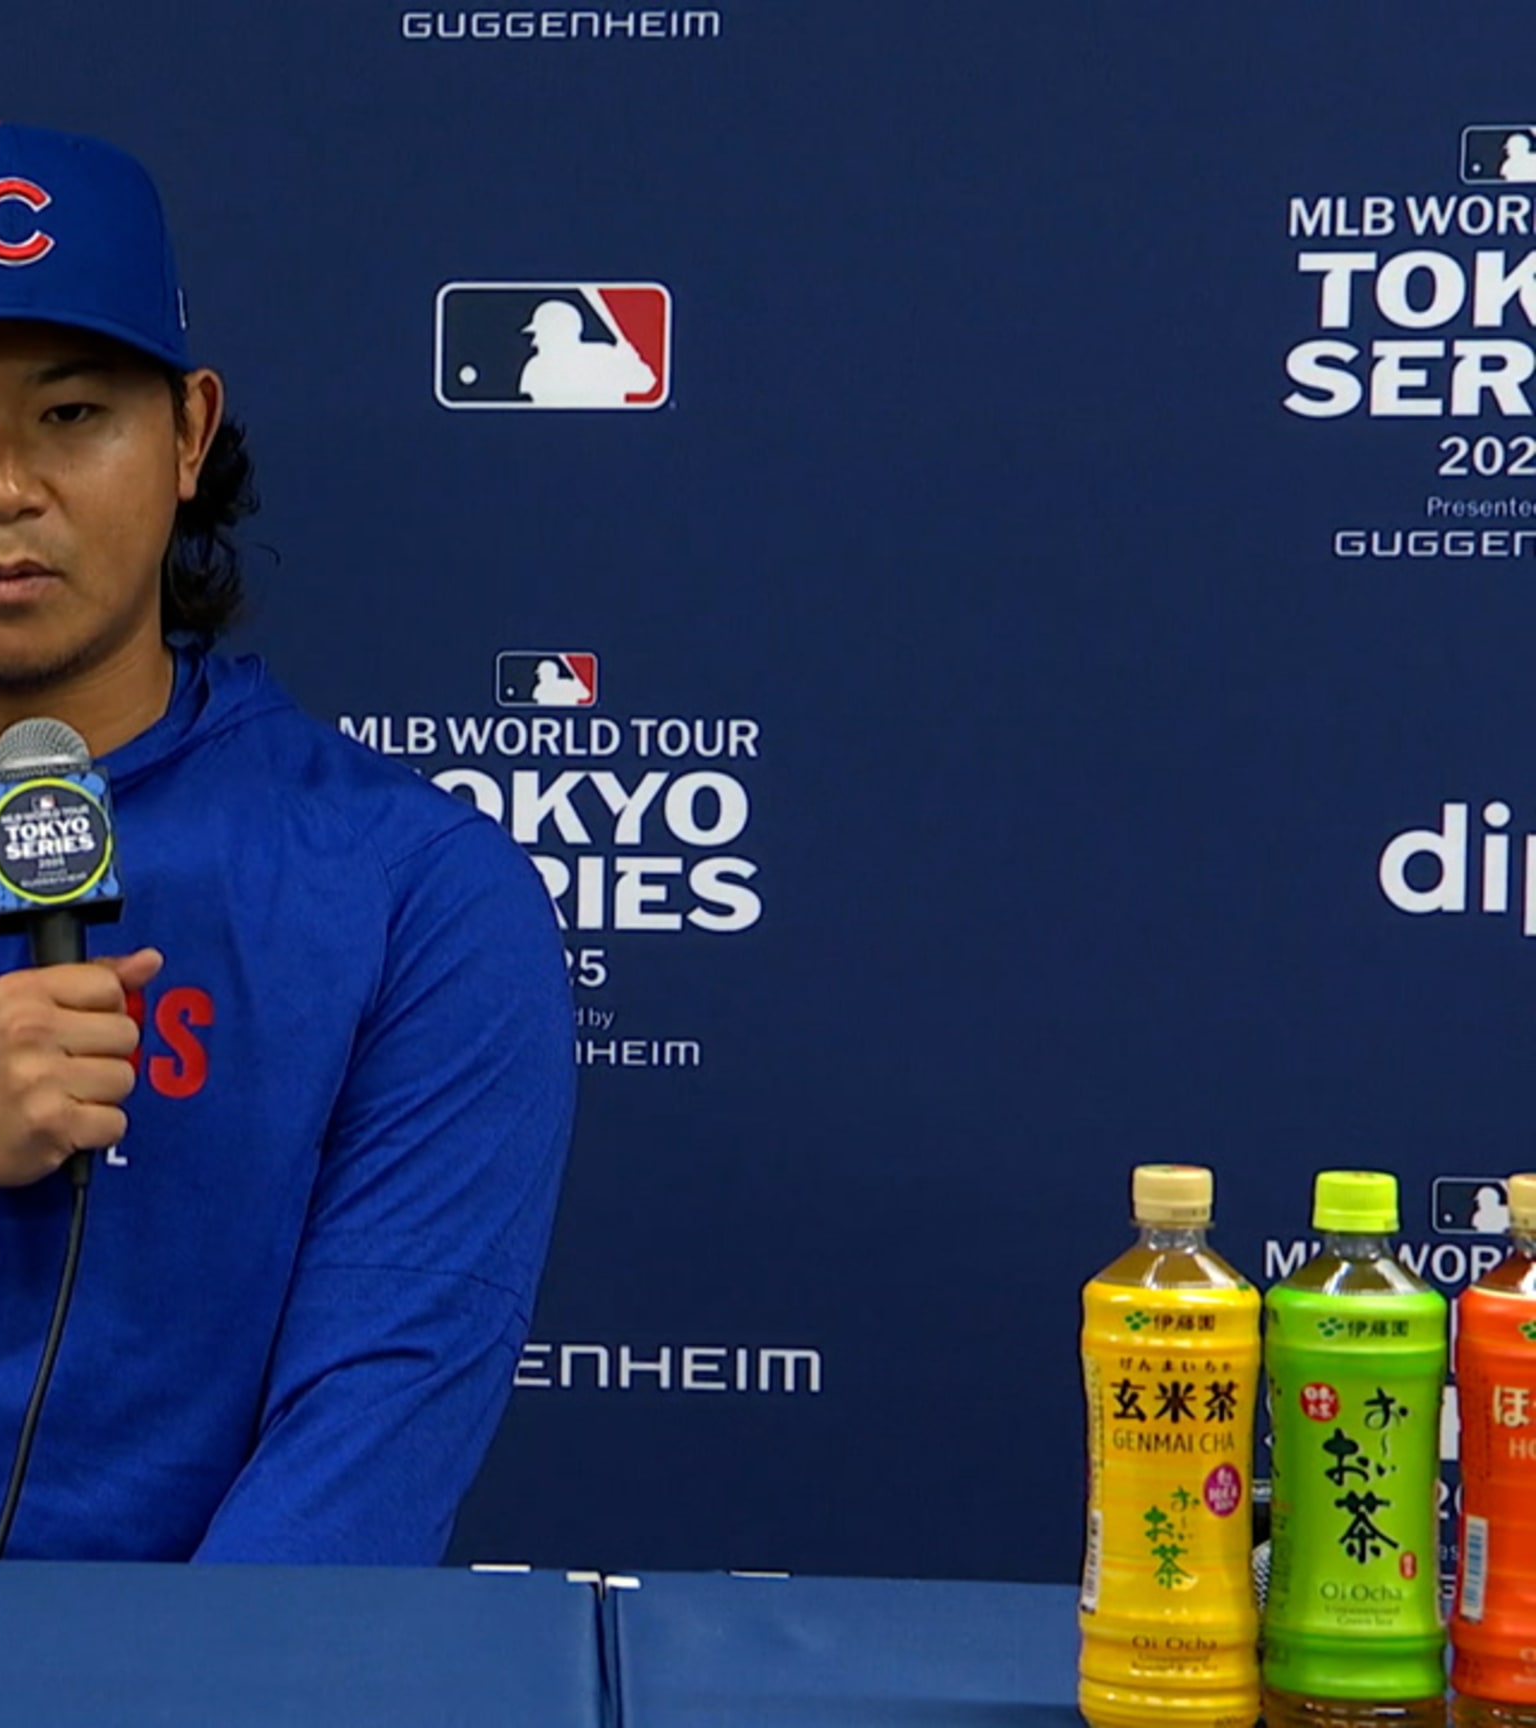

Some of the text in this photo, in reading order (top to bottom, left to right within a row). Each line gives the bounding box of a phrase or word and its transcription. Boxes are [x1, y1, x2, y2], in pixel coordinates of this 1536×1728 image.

[402, 11, 720, 38] GUGGENHEIM
[1291, 196, 1536, 235] MLB WOR
[1427, 496, 1536, 518] Presente
[447, 718, 619, 754] WORLD
[631, 720, 758, 756] TOUR
[4, 815, 91, 842] TOKYO
[4, 832, 96, 861] SERIES
[1379, 801, 1536, 936] di
[588, 1007, 614, 1031] by
[576, 1040, 700, 1066] HEIM
[1153, 1313, 1216, 1332] 伊藤園
[1109, 1377, 1239, 1424] 玄米茶
[1492, 1384, 1536, 1428] ほ
[1112, 1427, 1235, 1455] GENMAI CHA
[1351, 1581, 1403, 1602] Ocha
[1165, 1634, 1218, 1651] Ocha
